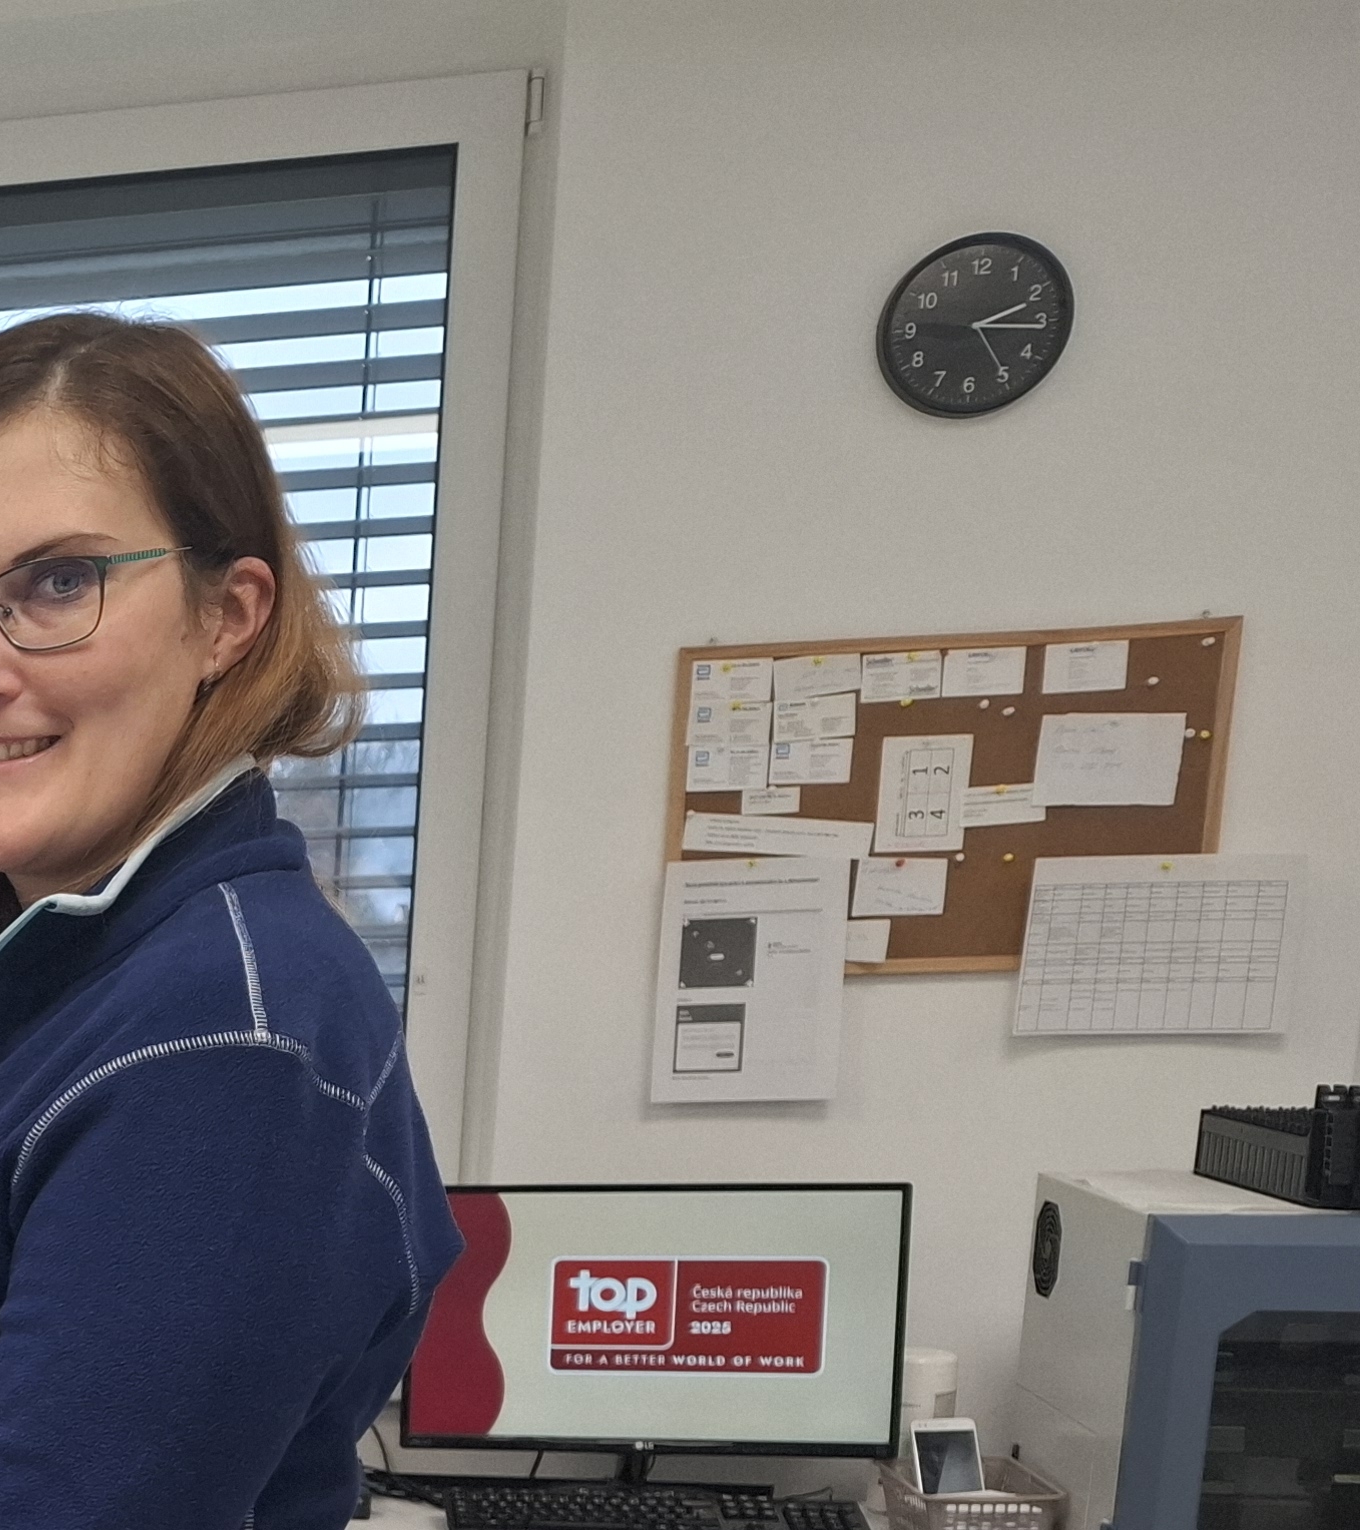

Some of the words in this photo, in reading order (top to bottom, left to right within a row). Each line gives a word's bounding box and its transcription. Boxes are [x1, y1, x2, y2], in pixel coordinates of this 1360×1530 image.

[971, 258, 993, 276] 12
[1010, 266, 1019, 282] 1
[941, 270, 959, 287] 11
[917, 292, 938, 309] 10
[1029, 285, 1042, 301] 2
[1034, 313, 1047, 328] 3
[904, 322, 916, 340] 9
[911, 351, 924, 368] 8
[1021, 344, 1033, 359] 4
[933, 371, 946, 388] 7
[997, 366, 1009, 383] 5
[962, 377, 975, 394] 6
[913, 766, 929, 776] 1
[934, 765, 951, 776] 2
[908, 810, 925, 820] 3
[930, 809, 946, 820] 4
[569, 1269, 657, 1320] top
[692, 1283, 733, 1300] Česká
[737, 1286, 803, 1303] republika
[691, 1299, 732, 1313] Czech
[736, 1300, 796, 1316] Republic
[567, 1319, 655, 1335] EMPLOYER
[565, 1353, 593, 1366] FOR
[599, 1354, 609, 1366] A
[615, 1353, 666, 1367] BETTER
[673, 1354, 726, 1367] WORLD
[733, 1355, 752, 1367] OF
[759, 1356, 805, 1368] WORK
